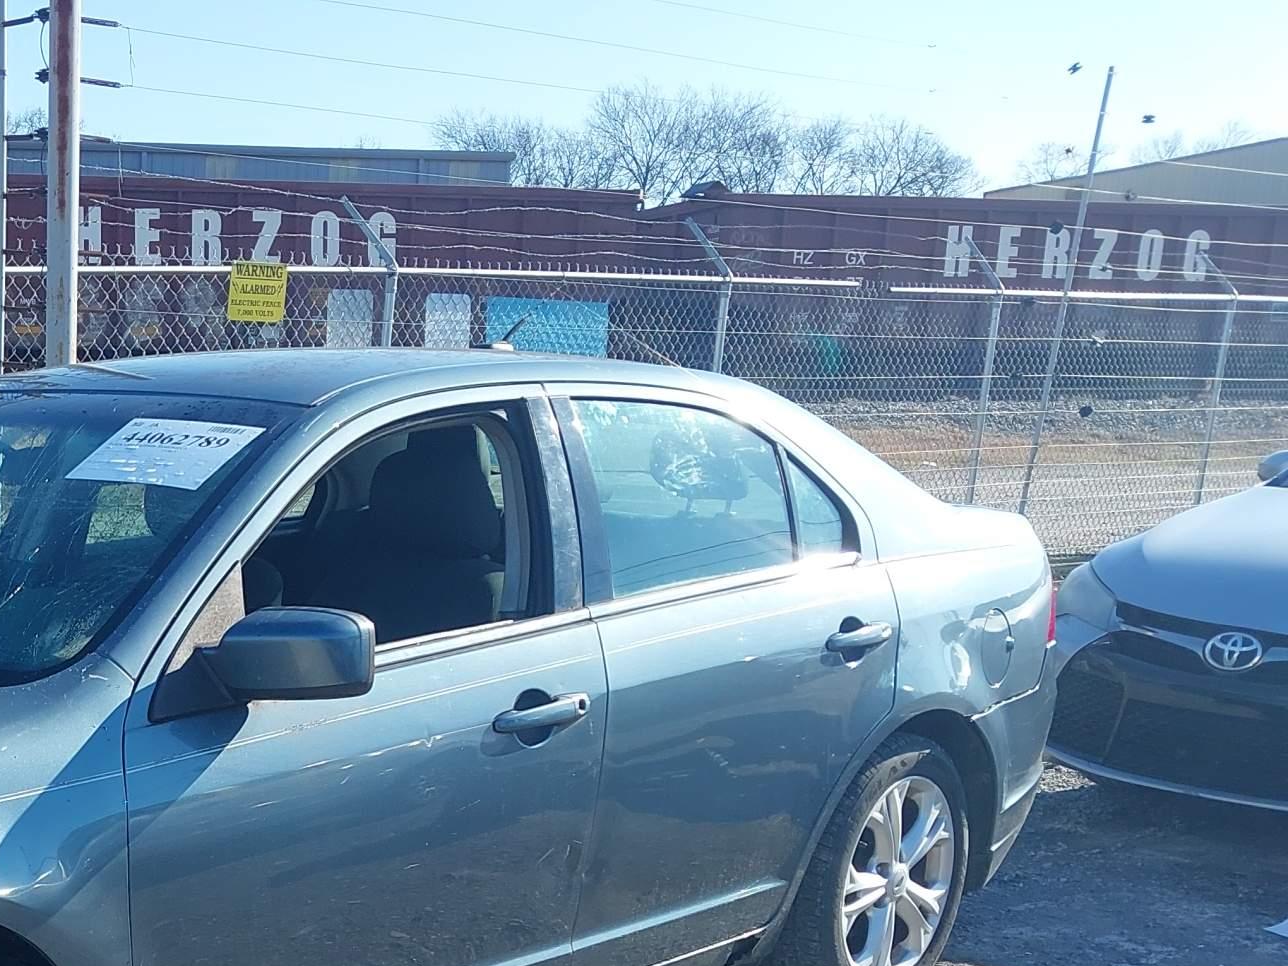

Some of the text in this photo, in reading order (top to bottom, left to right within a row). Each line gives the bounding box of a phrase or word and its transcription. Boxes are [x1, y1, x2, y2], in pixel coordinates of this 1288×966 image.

[79, 206, 397, 266] HERZOG
[793, 251, 866, 266] HZ GX
[943, 225, 1211, 282] HERZOG
[236, 263, 284, 278] WARNING
[240, 283, 276, 296] ALARMED
[231, 299, 282, 308] ELECTRIC FENCE
[255, 309, 274, 317] VOLTS
[122, 431, 231, 449] 44062789
